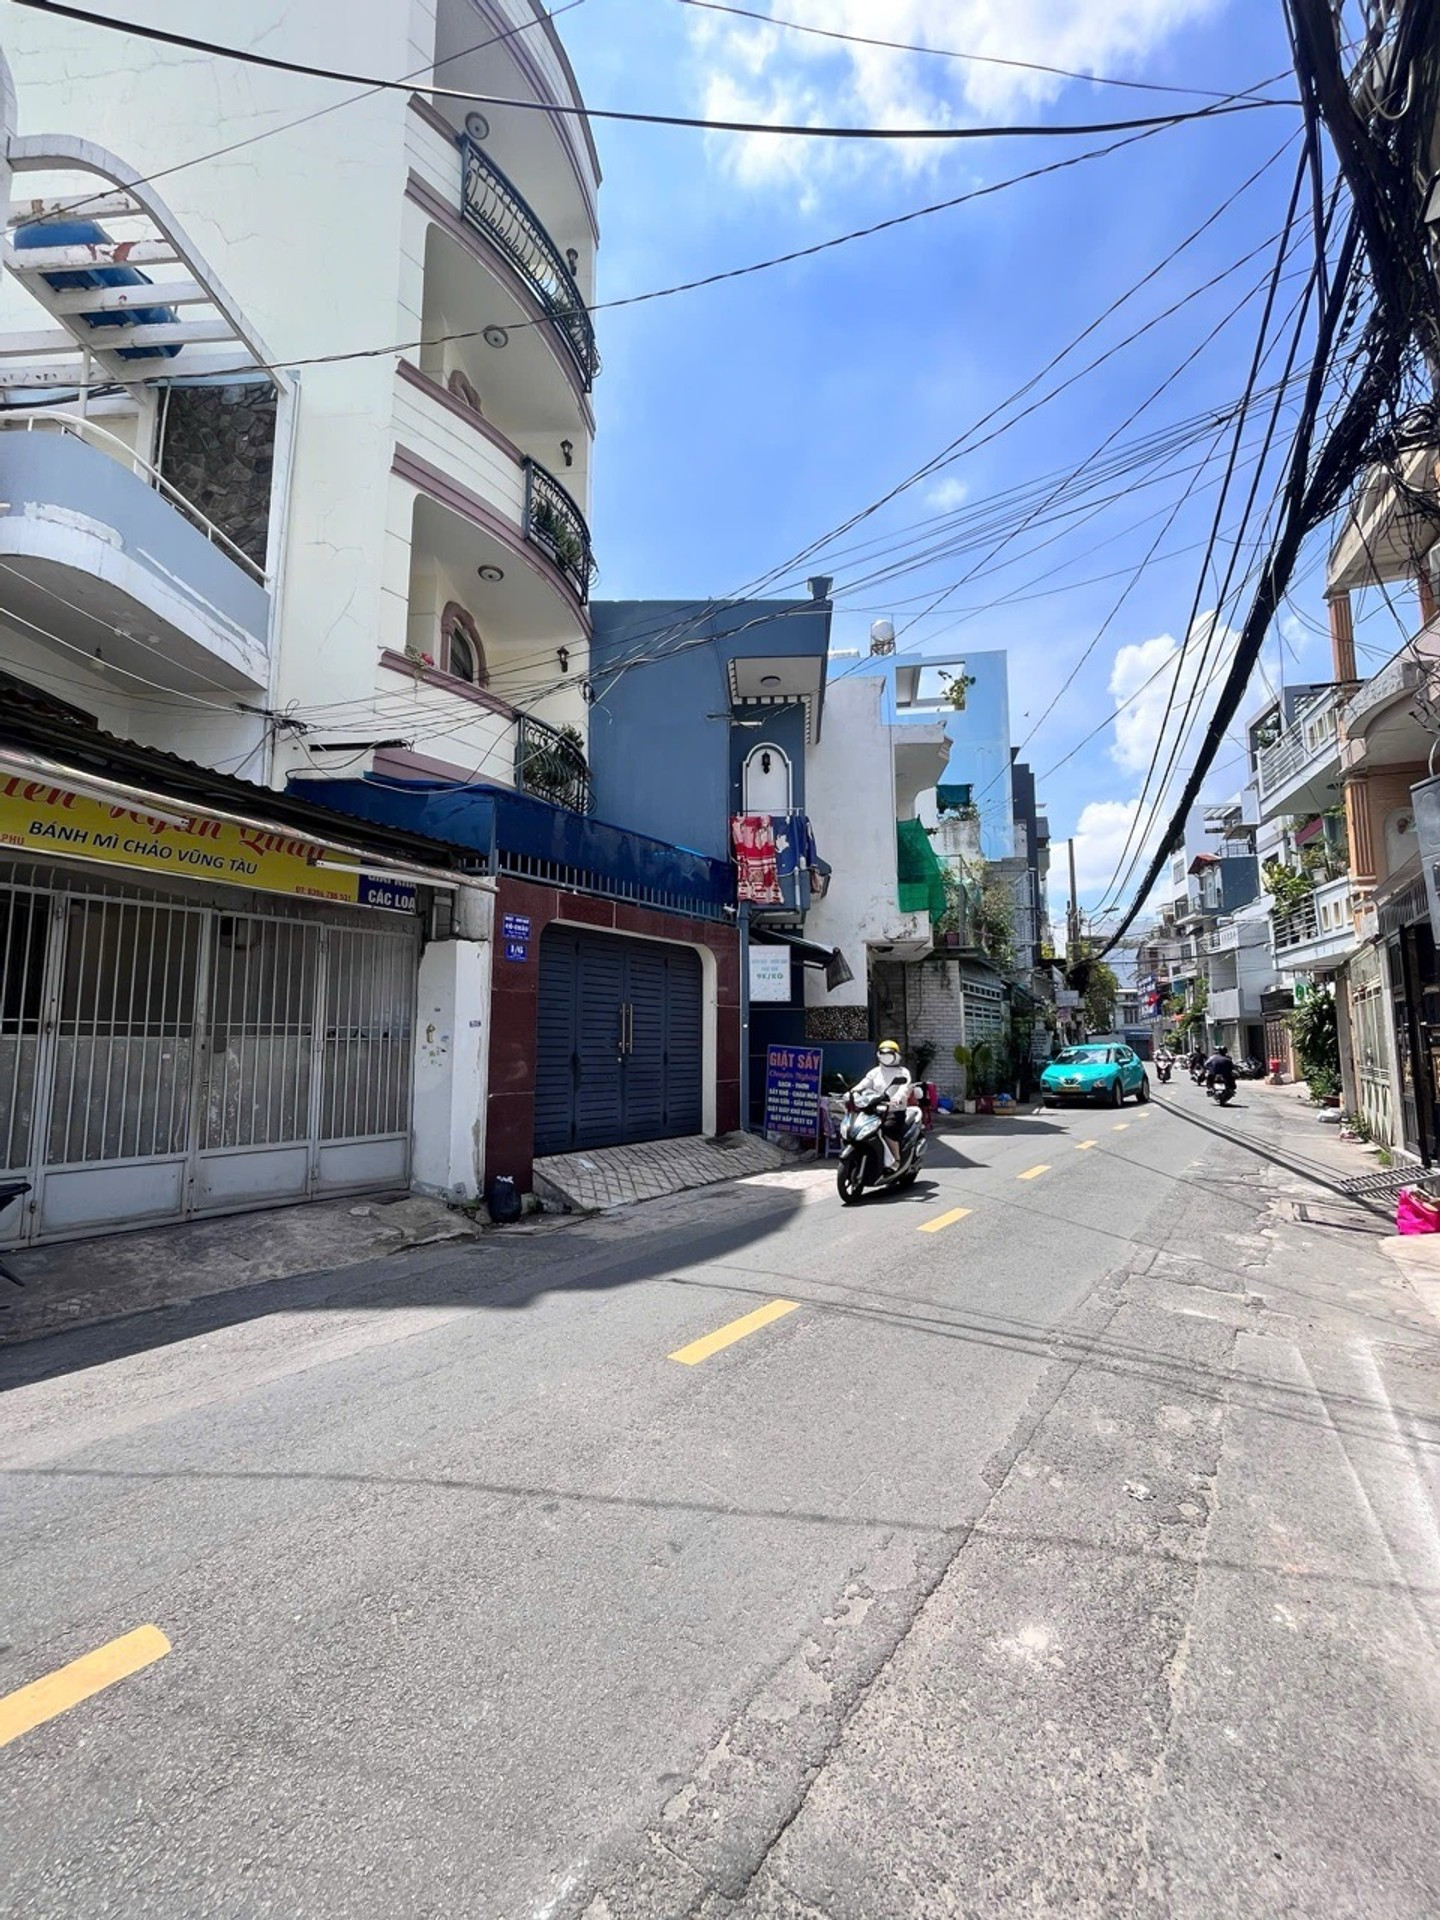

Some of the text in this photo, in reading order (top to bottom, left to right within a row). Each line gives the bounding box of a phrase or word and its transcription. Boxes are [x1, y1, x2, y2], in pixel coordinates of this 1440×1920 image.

[29, 821, 88, 844] BÁNH
[93, 832, 119, 848] MÌ
[178, 849, 224, 868] VŨNG
[230, 858, 258, 874] TÀU
[368, 888, 392, 906] CÁC
[770, 1050, 820, 1070] GIẶT SẤY
